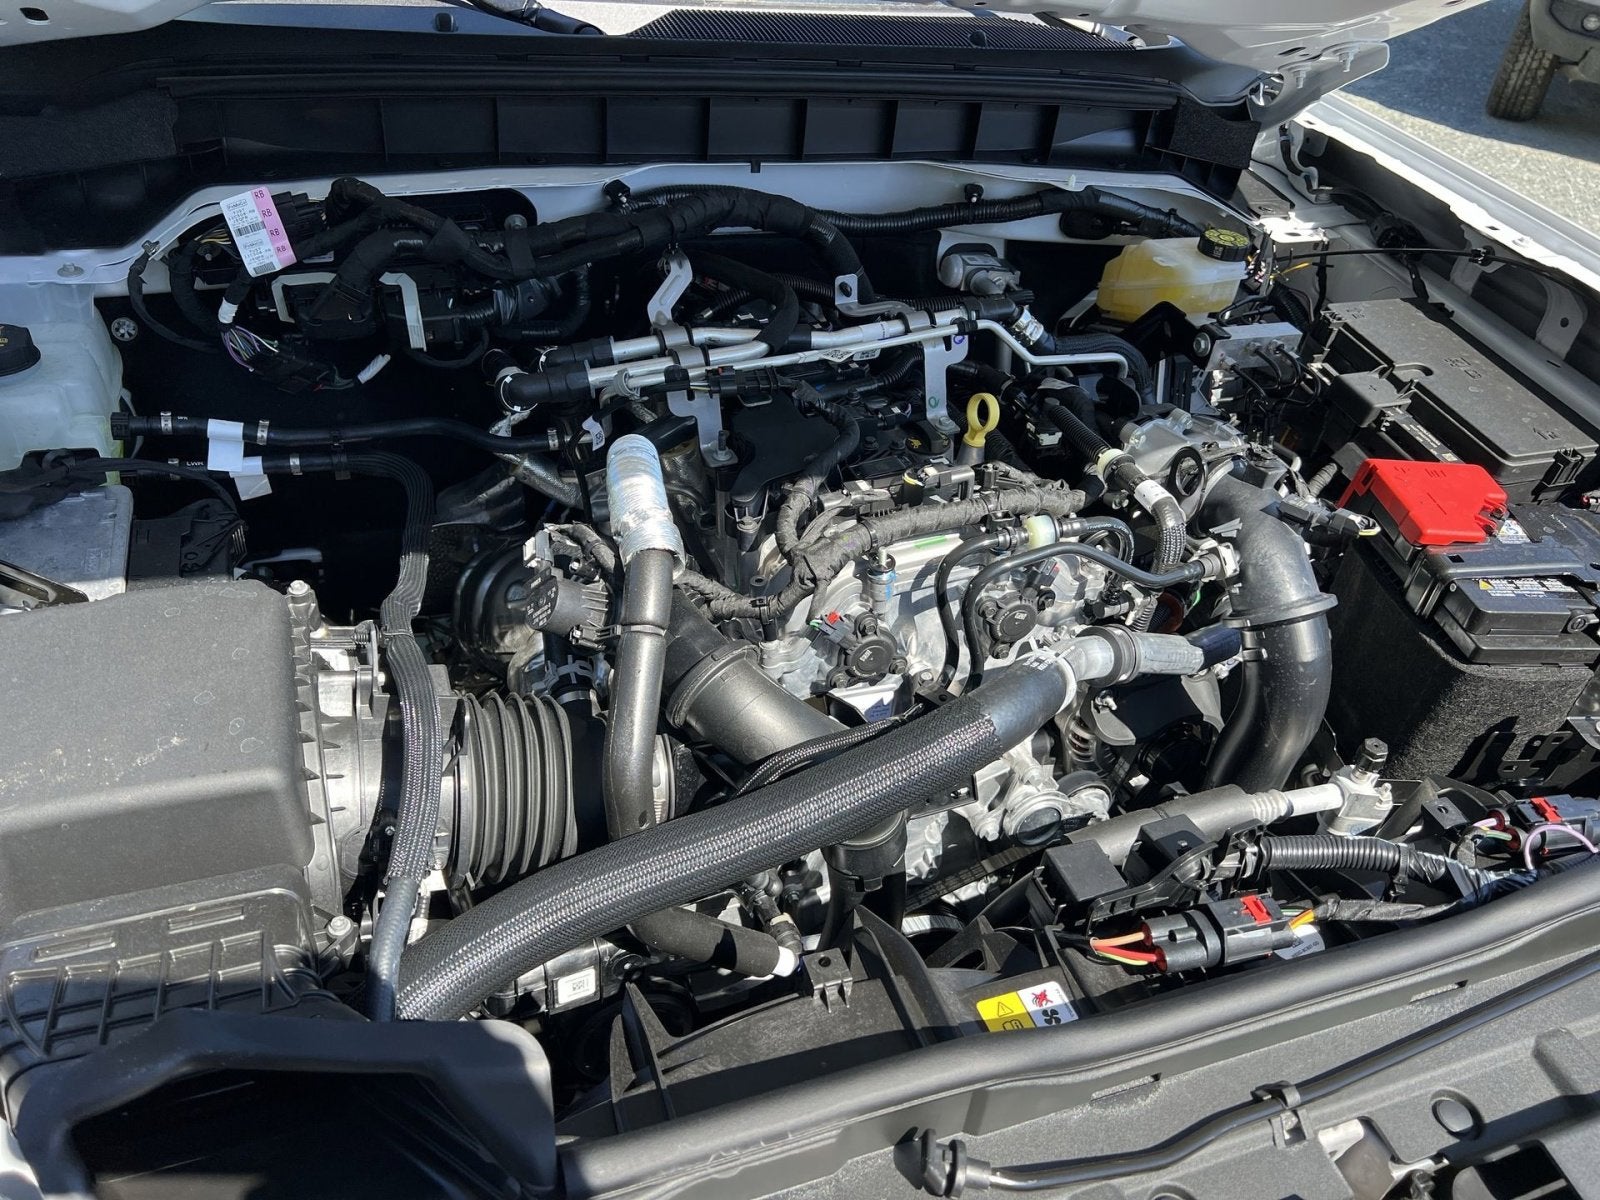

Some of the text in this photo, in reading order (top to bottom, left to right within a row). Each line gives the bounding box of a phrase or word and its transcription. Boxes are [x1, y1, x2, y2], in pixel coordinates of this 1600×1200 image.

[254, 189, 265, 199] RB
[261, 208, 273, 218] RB
[269, 228, 280, 237] RB
[276, 245, 287, 253] RB
